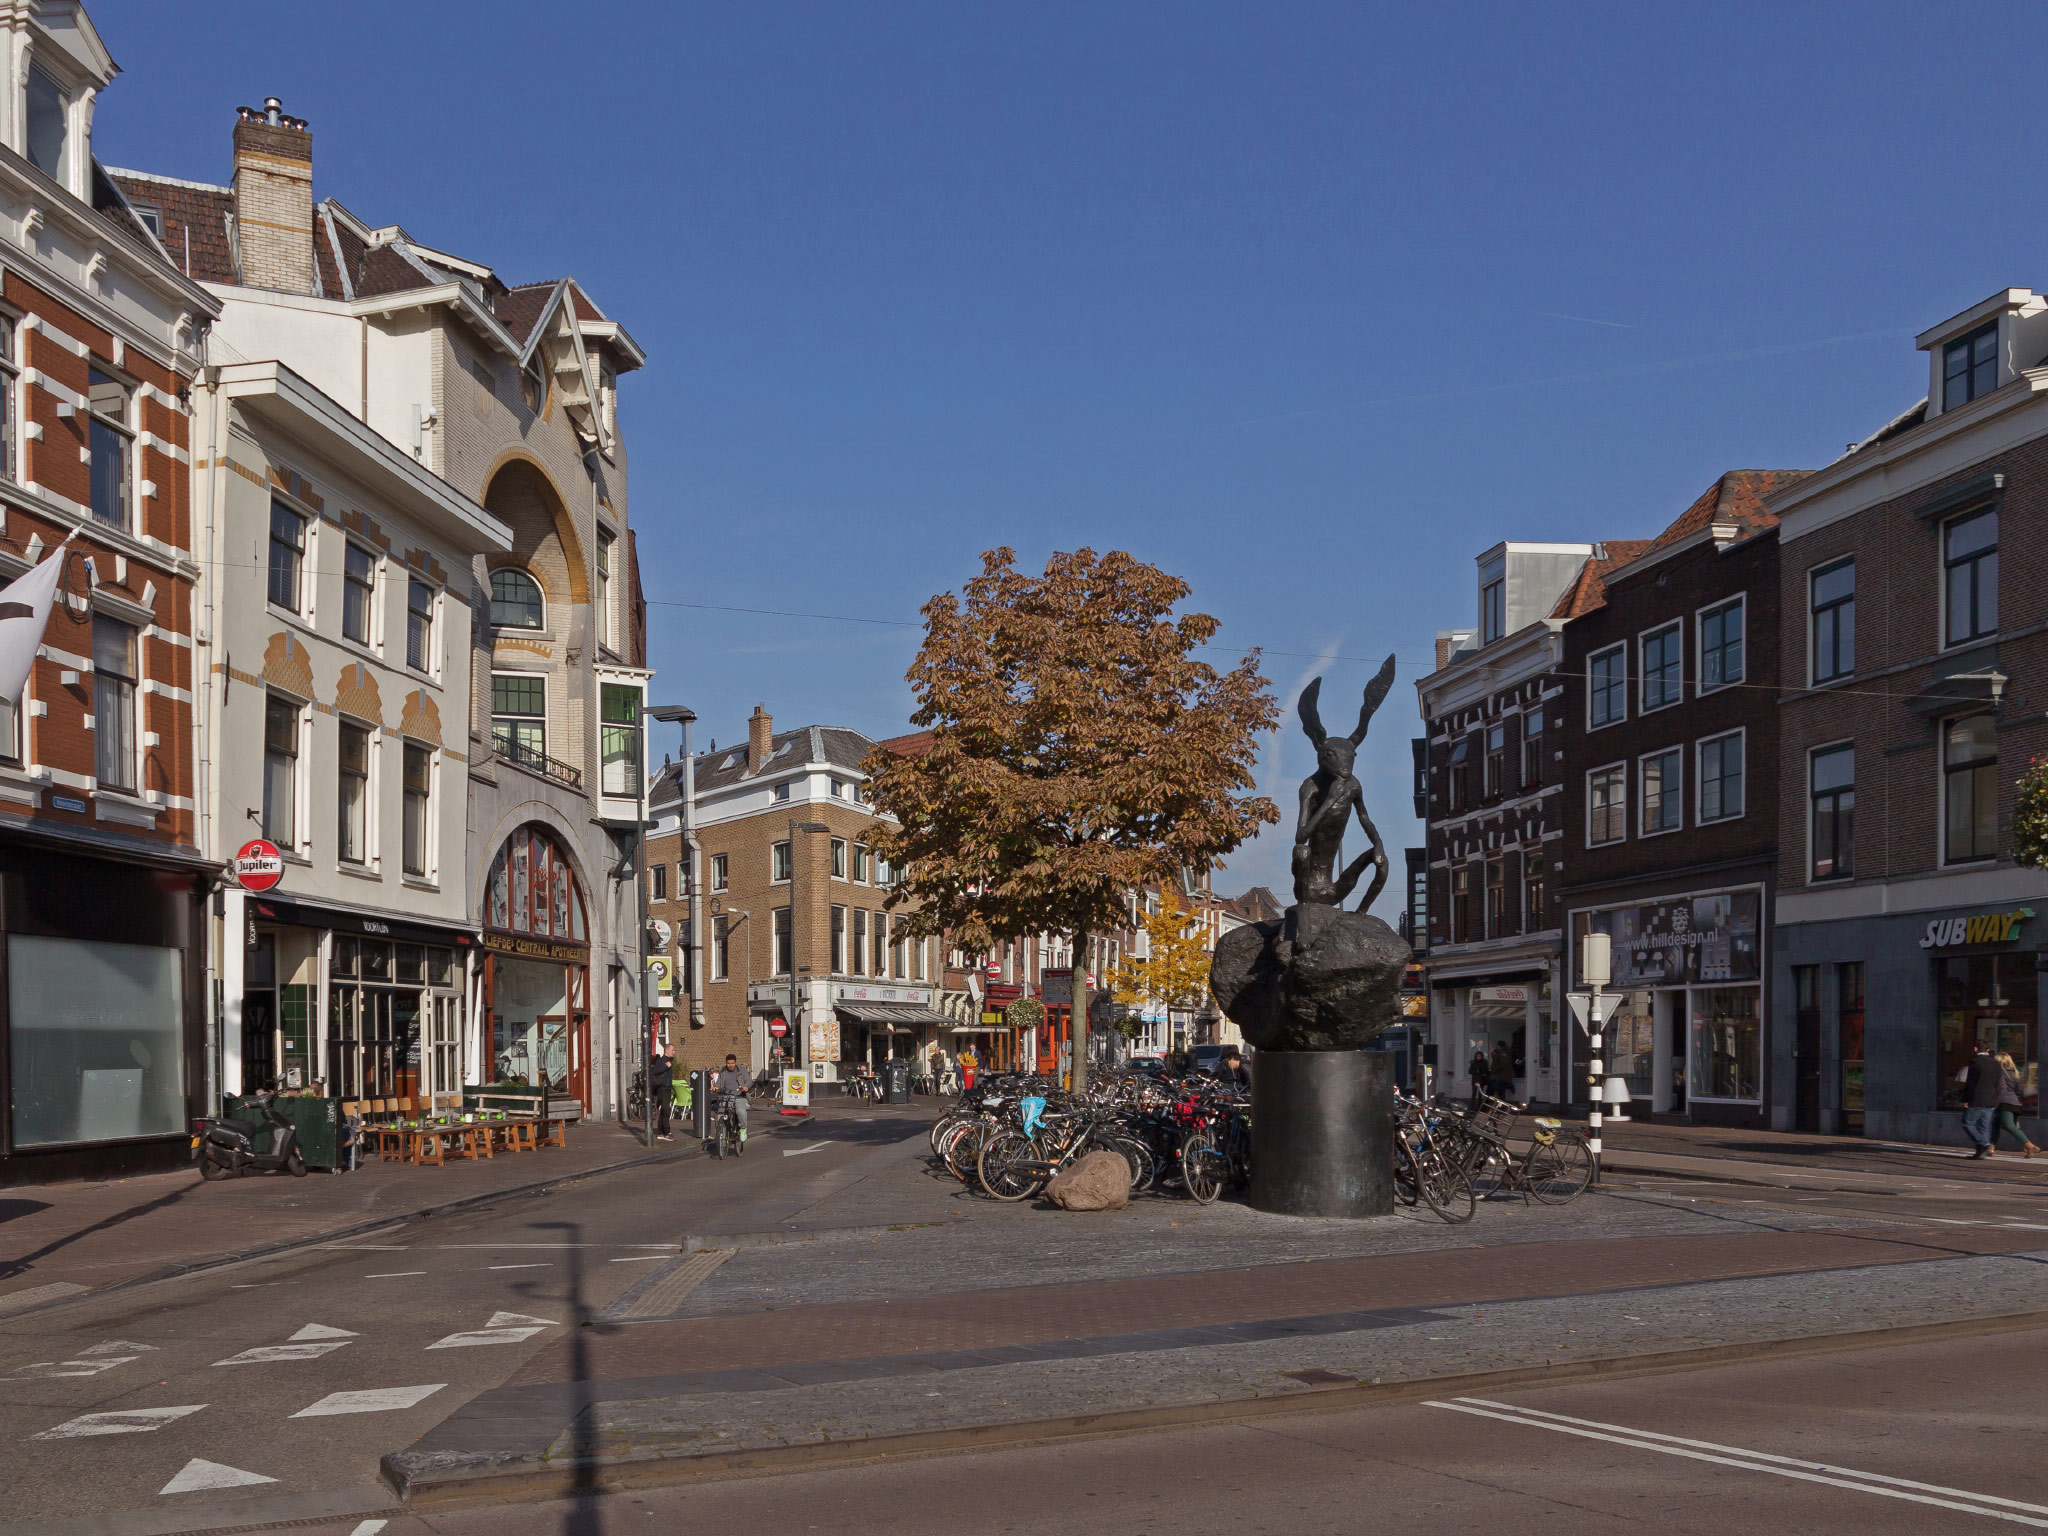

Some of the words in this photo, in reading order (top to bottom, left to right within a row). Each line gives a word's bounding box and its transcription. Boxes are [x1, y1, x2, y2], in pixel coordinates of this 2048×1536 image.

[239, 859, 277, 872] Jupiler
[1624, 926, 1718, 951] www.hilldesign.nl
[1919, 908, 2034, 948] SUBWAY
